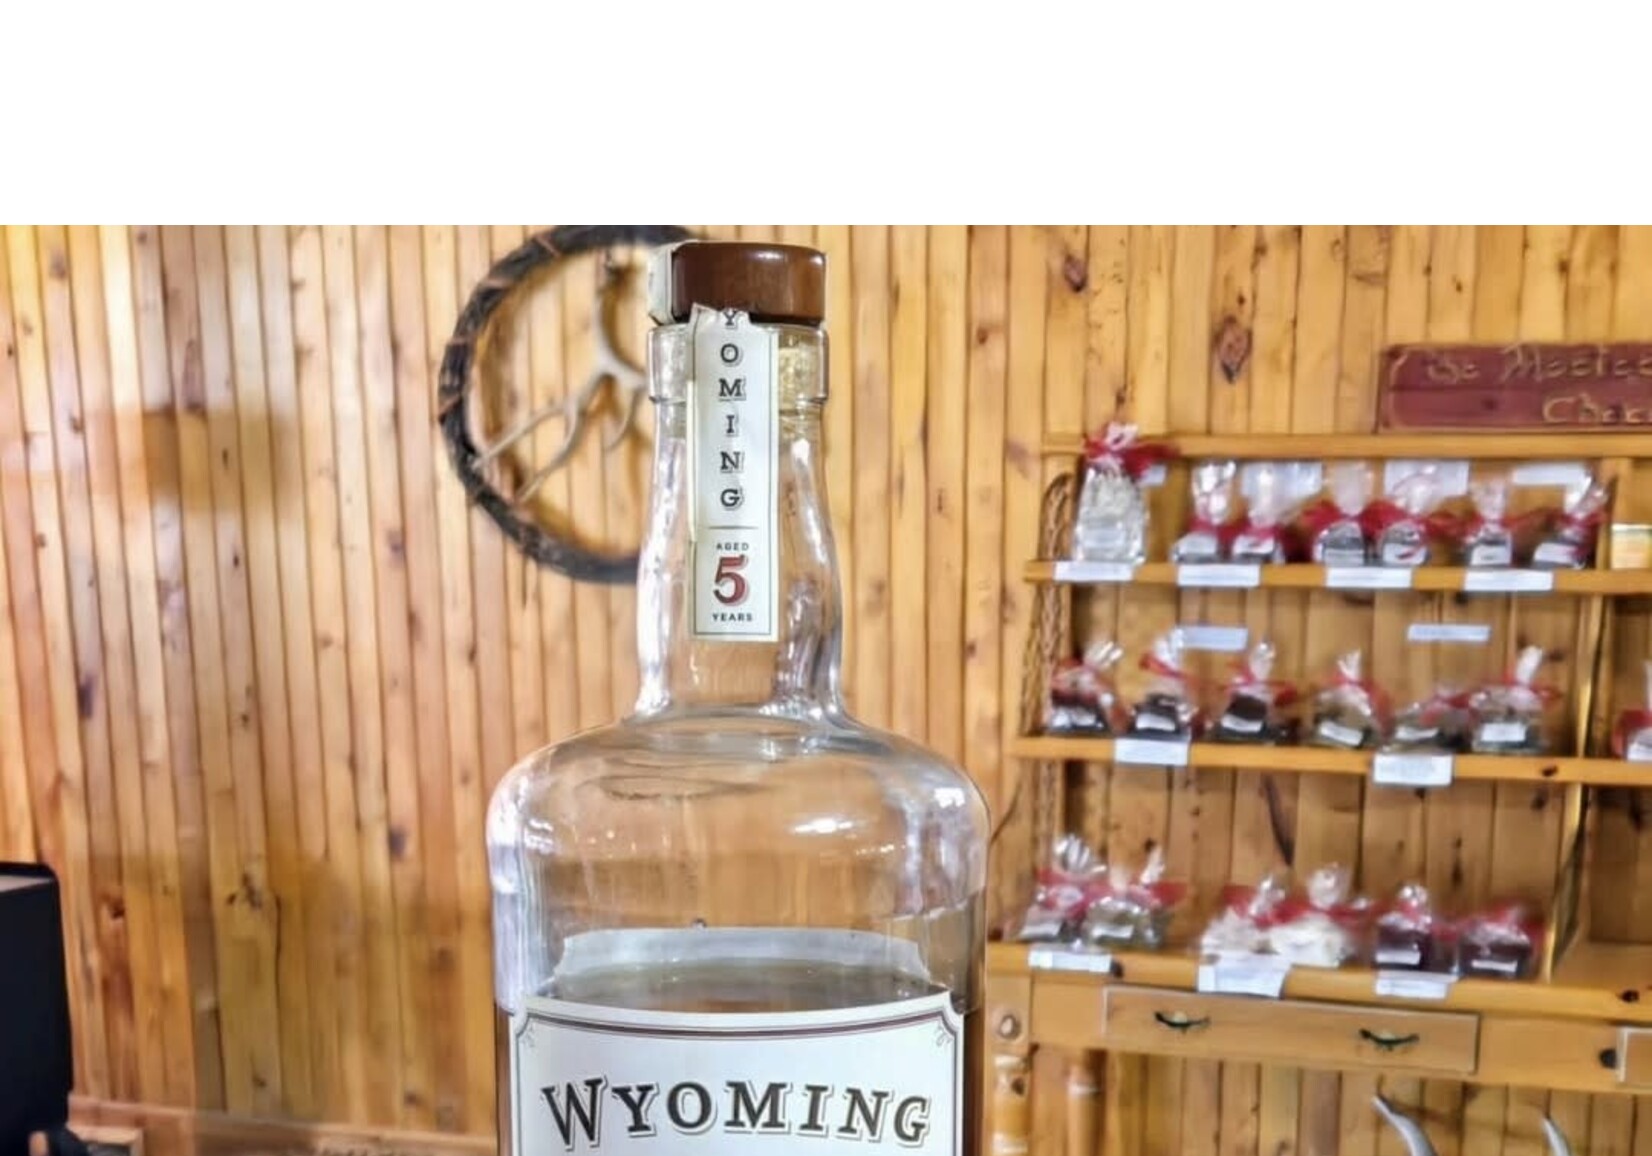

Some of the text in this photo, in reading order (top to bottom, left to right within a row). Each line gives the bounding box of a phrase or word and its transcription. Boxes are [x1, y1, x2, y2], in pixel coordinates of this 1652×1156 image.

[716, 542, 750, 551] AGED
[712, 554, 750, 606] 5
[711, 612, 753, 622] YEARS
[541, 1074, 932, 1152] WYOMING
